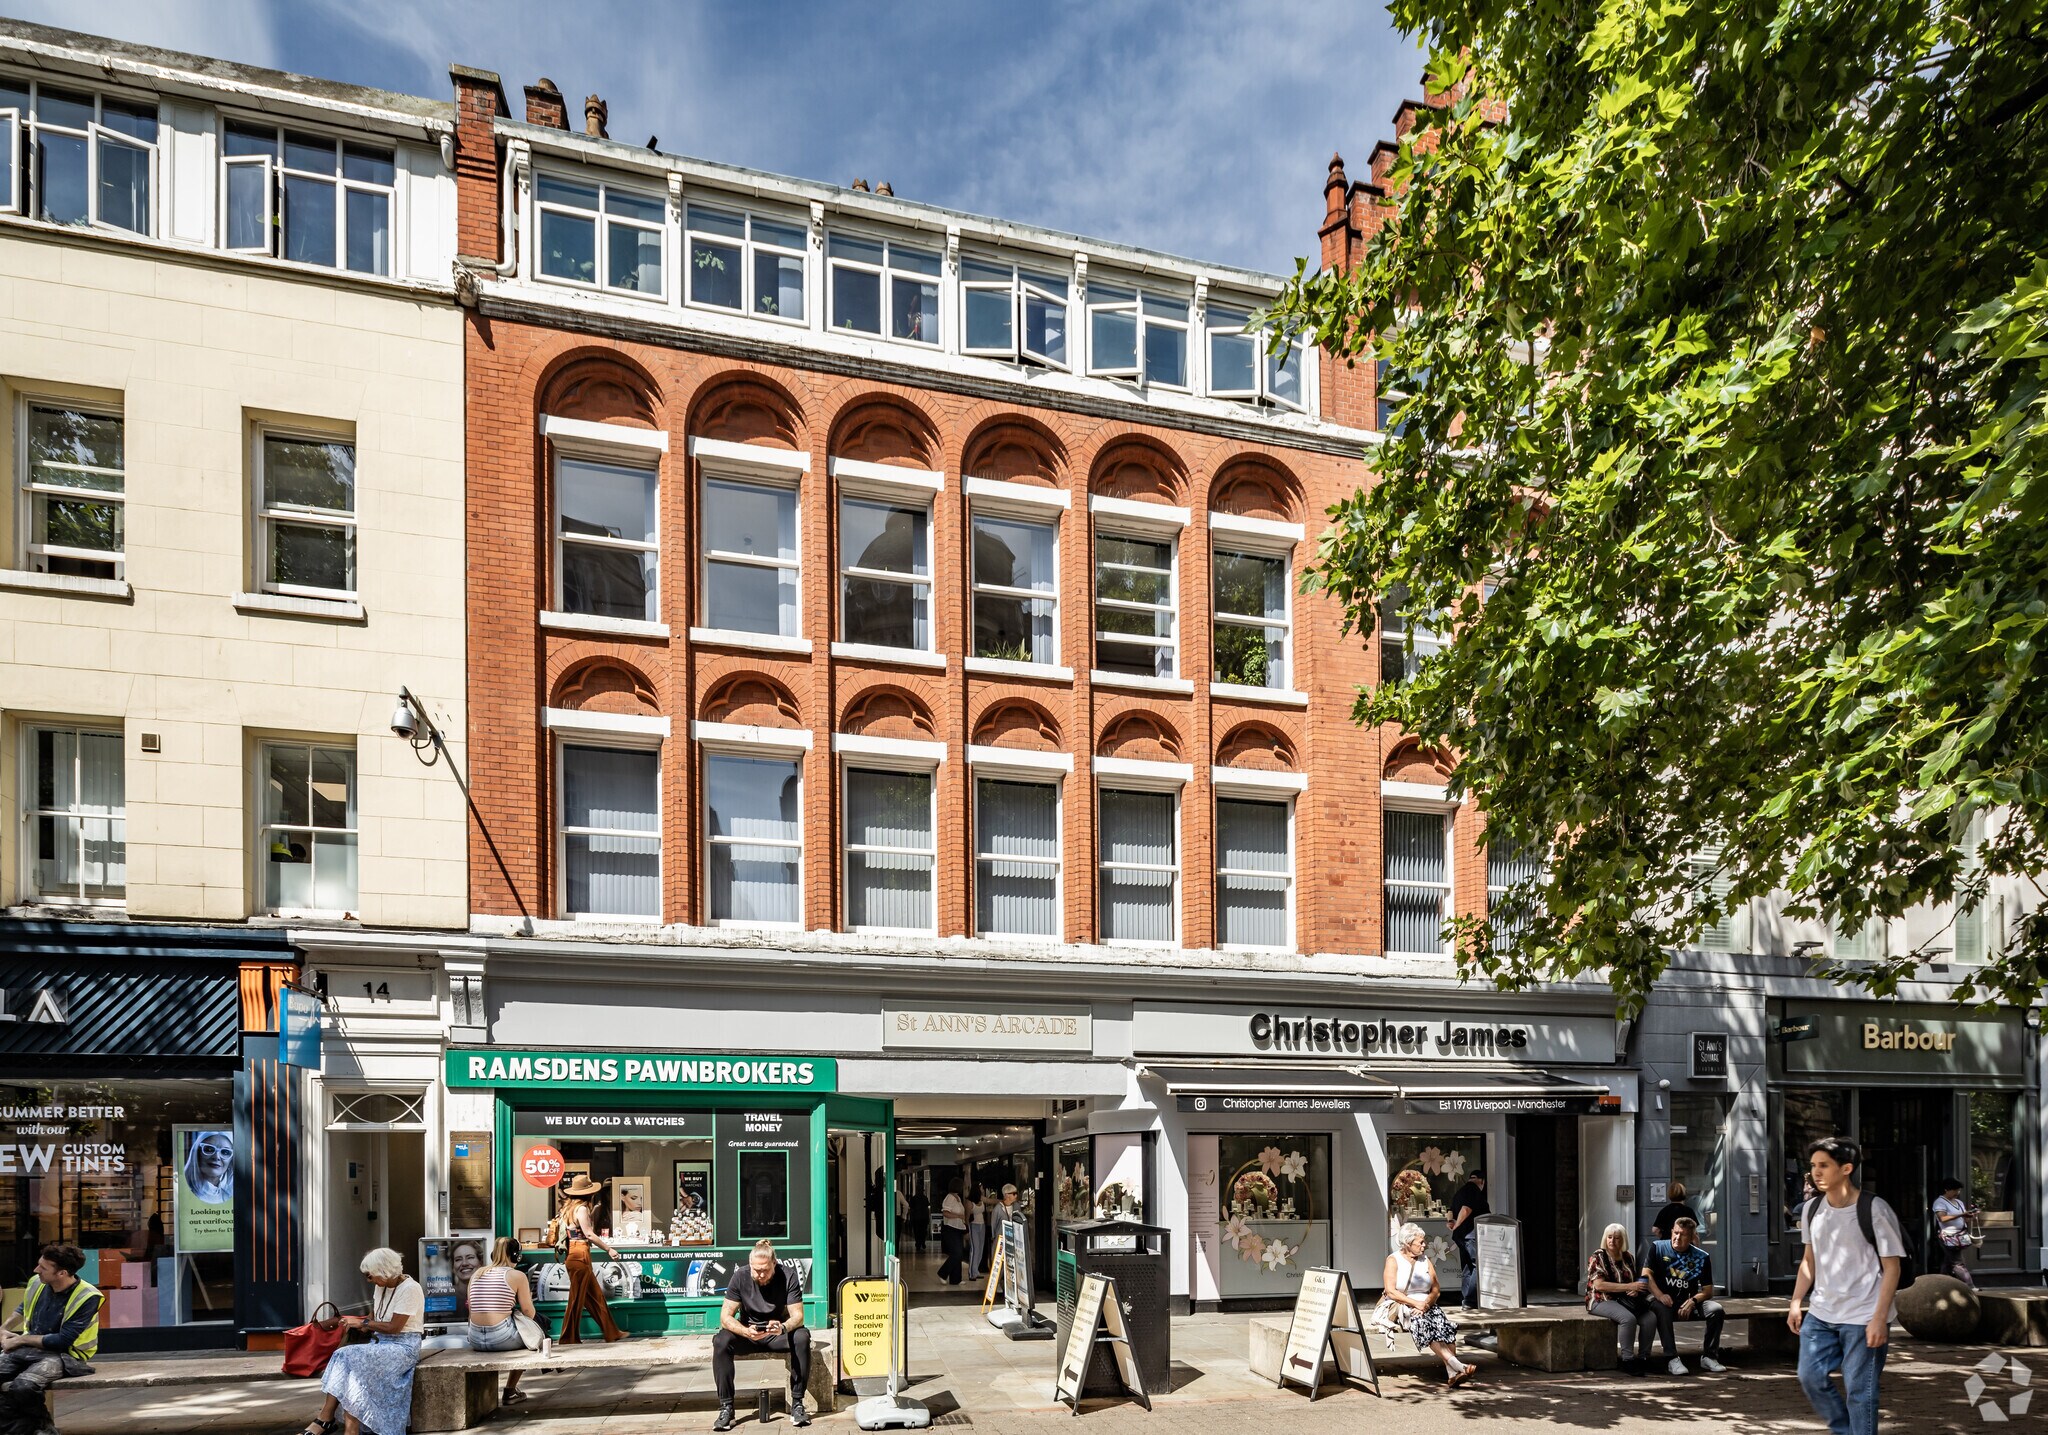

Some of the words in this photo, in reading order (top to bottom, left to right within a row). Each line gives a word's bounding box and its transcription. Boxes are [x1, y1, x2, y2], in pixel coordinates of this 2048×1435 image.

[363, 982, 391, 1003] 14
[897, 1014, 918, 1031] St
[923, 1014, 987, 1033] ANN'S
[992, 1016, 1077, 1035] ARCADE
[1782, 1024, 1810, 1034] Barbour
[1250, 1013, 1428, 1050] Christopher
[1435, 1020, 1527, 1048] James
[1864, 1023, 1956, 1051] Barbour
[468, 1056, 618, 1081] RAMSDENS
[625, 1059, 814, 1085] PAWNBROKERS
[1223, 1098, 1276, 1110] Christopher
[1278, 1099, 1308, 1109] James
[1310, 1099, 1351, 1109] Jewellers
[1439, 1101, 1451, 1110] Est
[1453, 1100, 1473, 1109] 1978
[1474, 1100, 1511, 1111] Liverpool
[1517, 1100, 1567, 1109] Manchester
[68, 1106, 125, 1118] BETTER
[744, 1113, 783, 1122] TRAVEL
[545, 1117, 562, 1125] WE
[565, 1117, 588, 1125] BUY
[590, 1117, 621, 1126] GOLD
[623, 1117, 632, 1126] &
[634, 1117, 685, 1126] WATCHES
[745, 1123, 782, 1132] MONEY
[16, 1123, 44, 1135] with
[46, 1127, 70, 1135] our
[62, 1143, 125, 1155] CUSTOM
[764, 1140, 799, 1148] guaranteed
[62, 1156, 125, 1172] TINTS
[190, 1208, 221, 1216] Looking
[1665, 1277, 1689, 1288] W88
